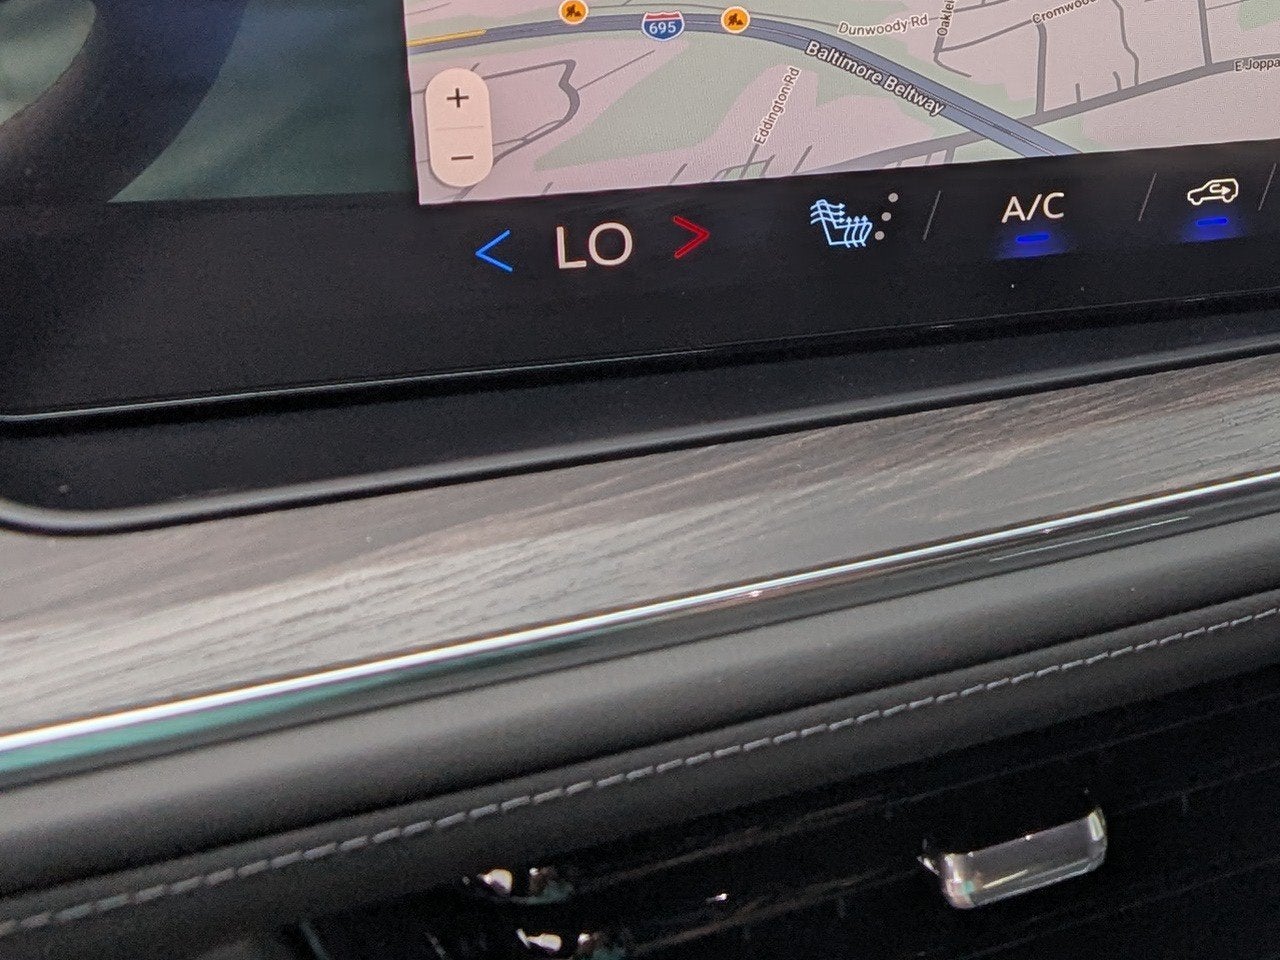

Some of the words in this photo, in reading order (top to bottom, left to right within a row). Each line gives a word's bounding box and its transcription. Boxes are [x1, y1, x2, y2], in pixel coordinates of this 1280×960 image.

[649, 20, 677, 35] 695
[838, 19, 908, 36] Dunwoody
[910, 14, 929, 27] Rd
[805, 40, 883, 86] Baltimore
[883, 76, 946, 116] Beltway
[1234, 60, 1243, 72] E
[1245, 57, 1280, 74] Joppa
[753, 84, 792, 146] Eddington
[784, 67, 801, 87] Rd
[1001, 191, 1065, 224] A/C
[556, 222, 633, 270] LO
